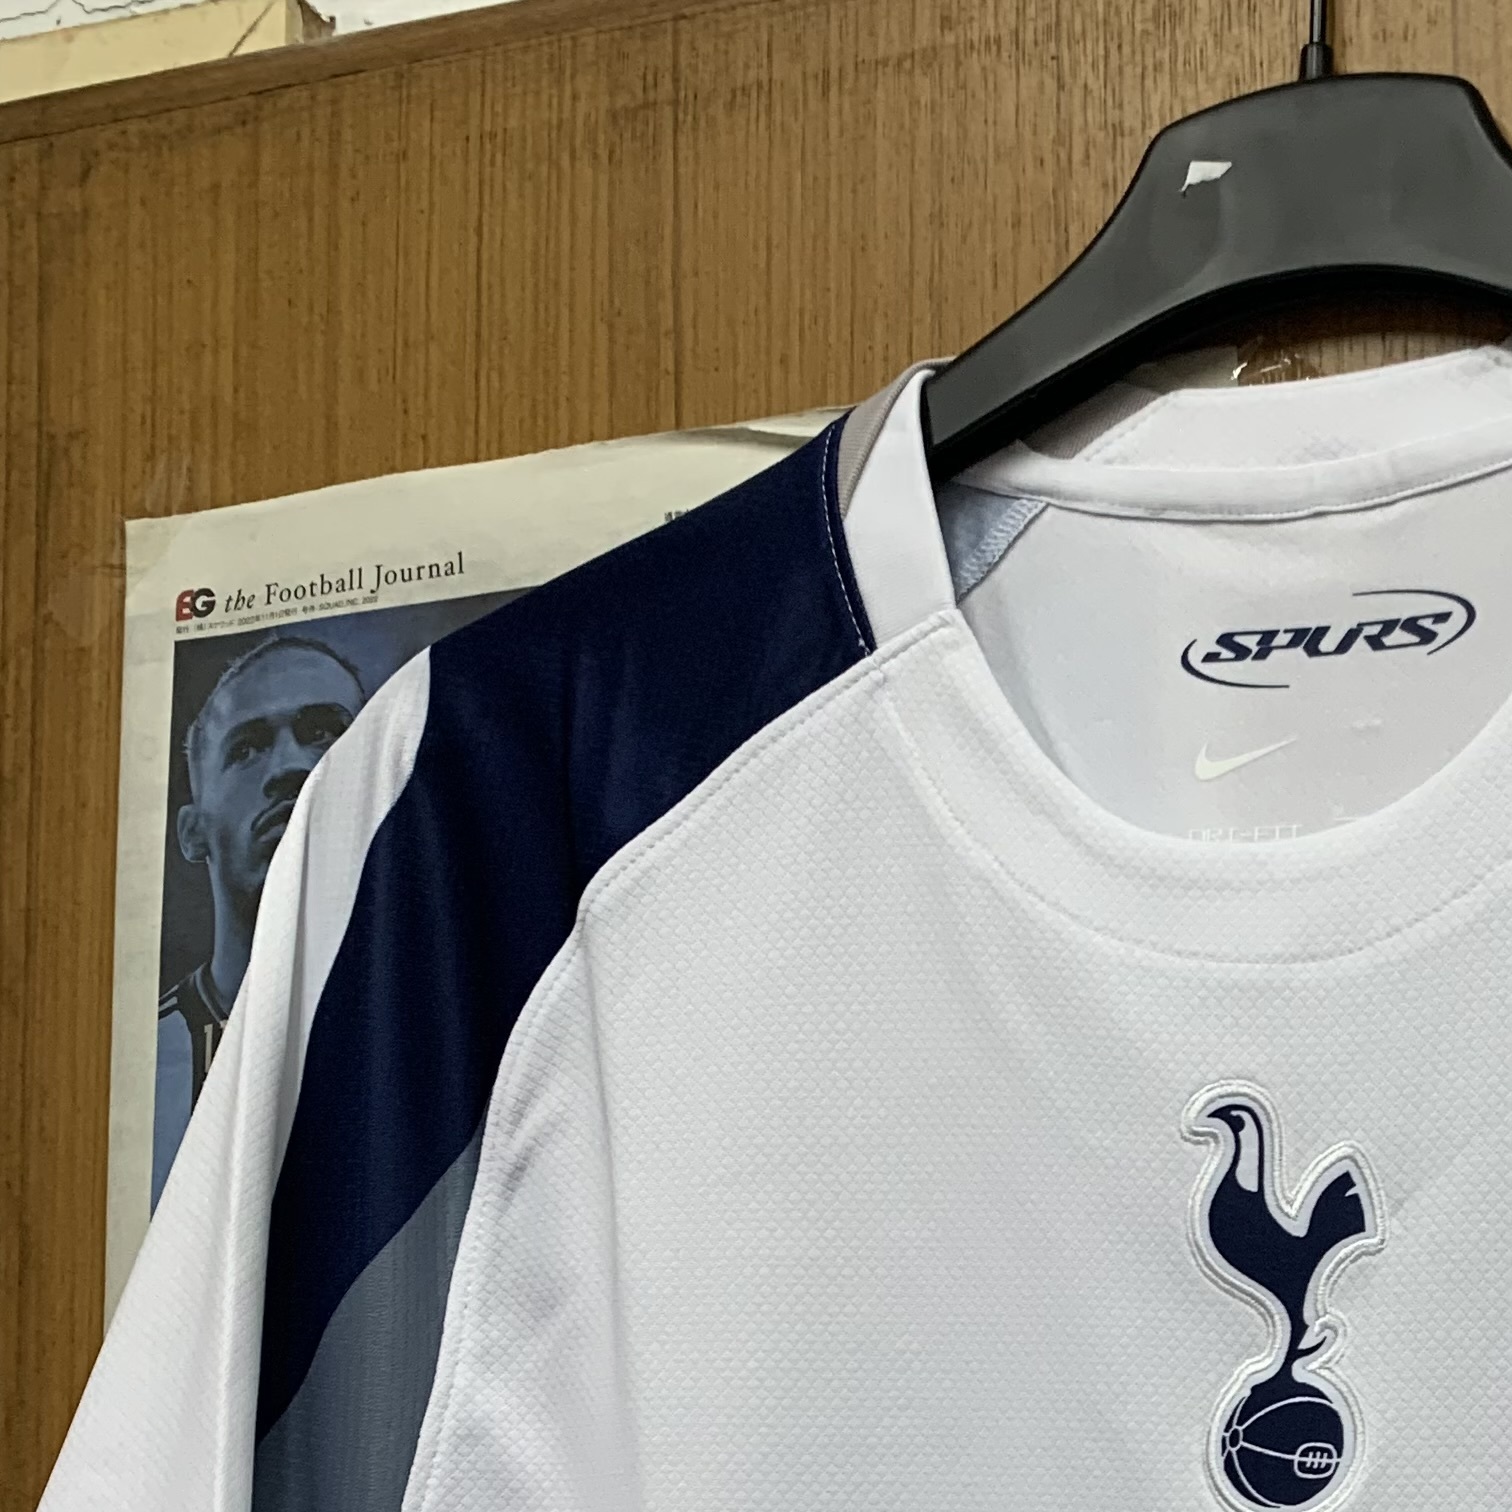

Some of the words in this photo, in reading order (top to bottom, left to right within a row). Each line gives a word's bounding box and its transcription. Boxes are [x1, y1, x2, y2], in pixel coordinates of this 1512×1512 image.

[175, 588, 216, 622] EG
[224, 589, 256, 613] the
[265, 567, 363, 605] Football
[370, 551, 465, 594] Journal
[1200, 611, 1453, 663] SPURS
